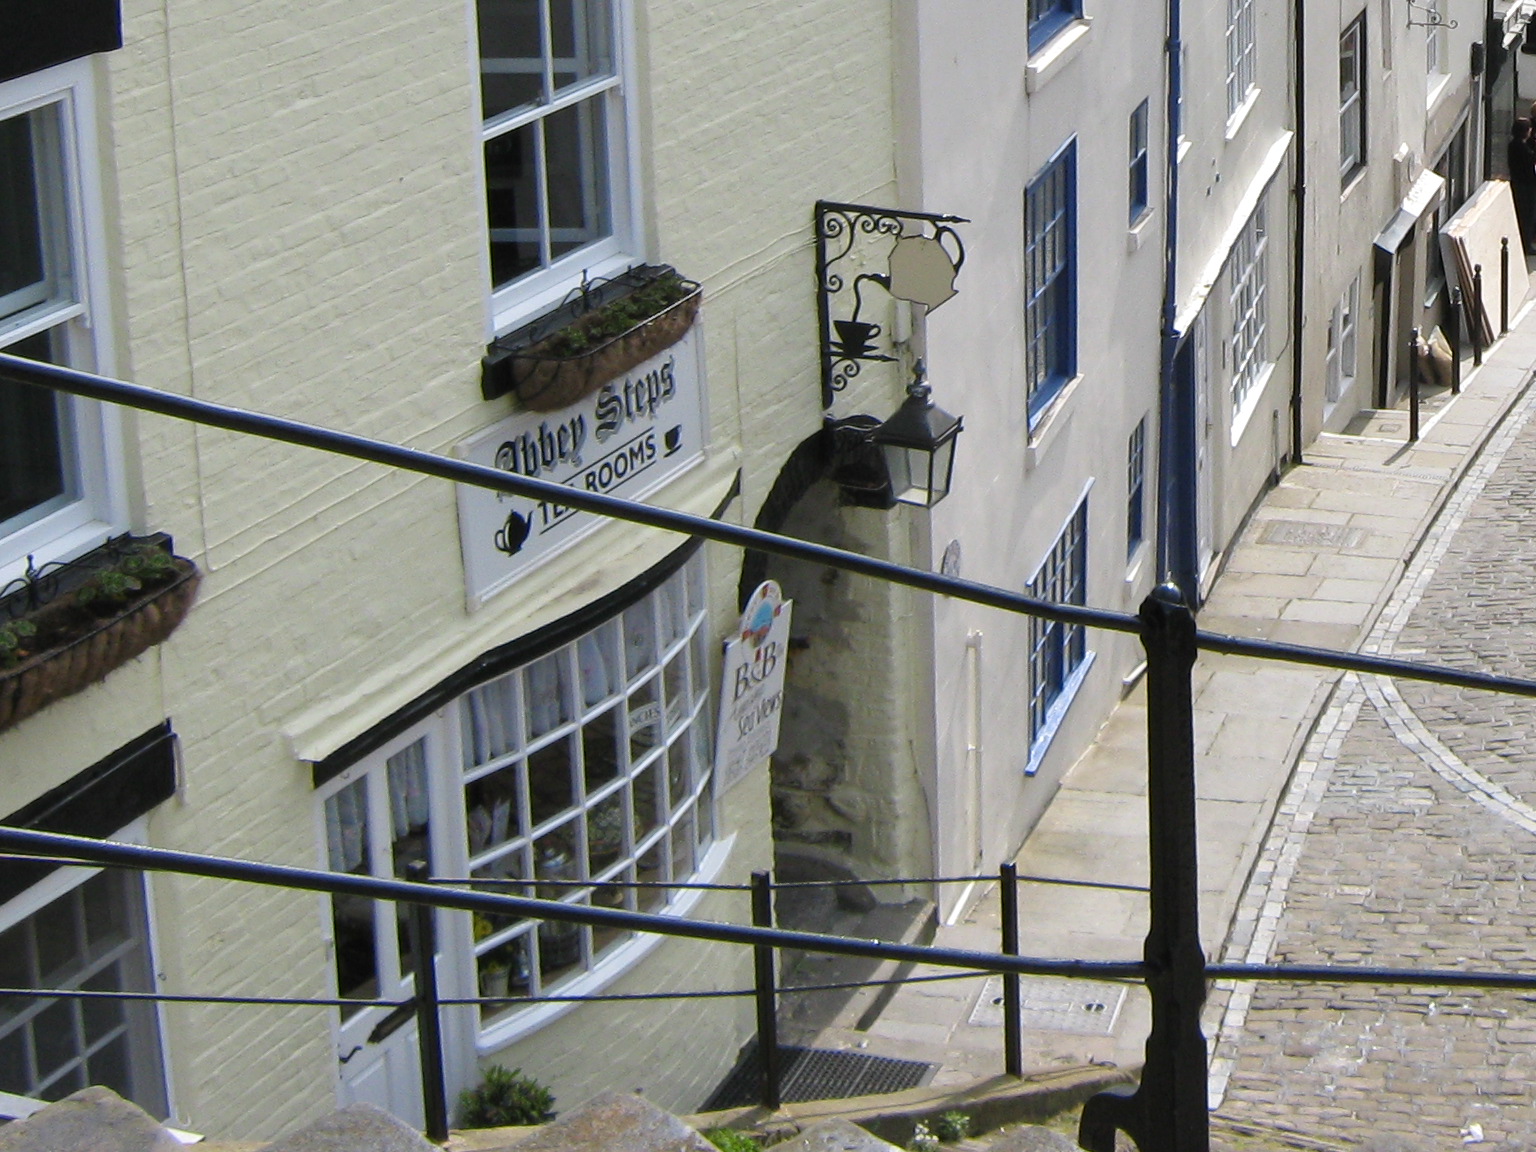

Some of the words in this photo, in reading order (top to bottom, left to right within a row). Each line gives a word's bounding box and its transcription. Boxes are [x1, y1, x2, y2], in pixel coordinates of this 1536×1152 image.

[494, 413, 588, 482] Abbey
[595, 355, 677, 444] Steps
[585, 434, 657, 494] ROOMS
